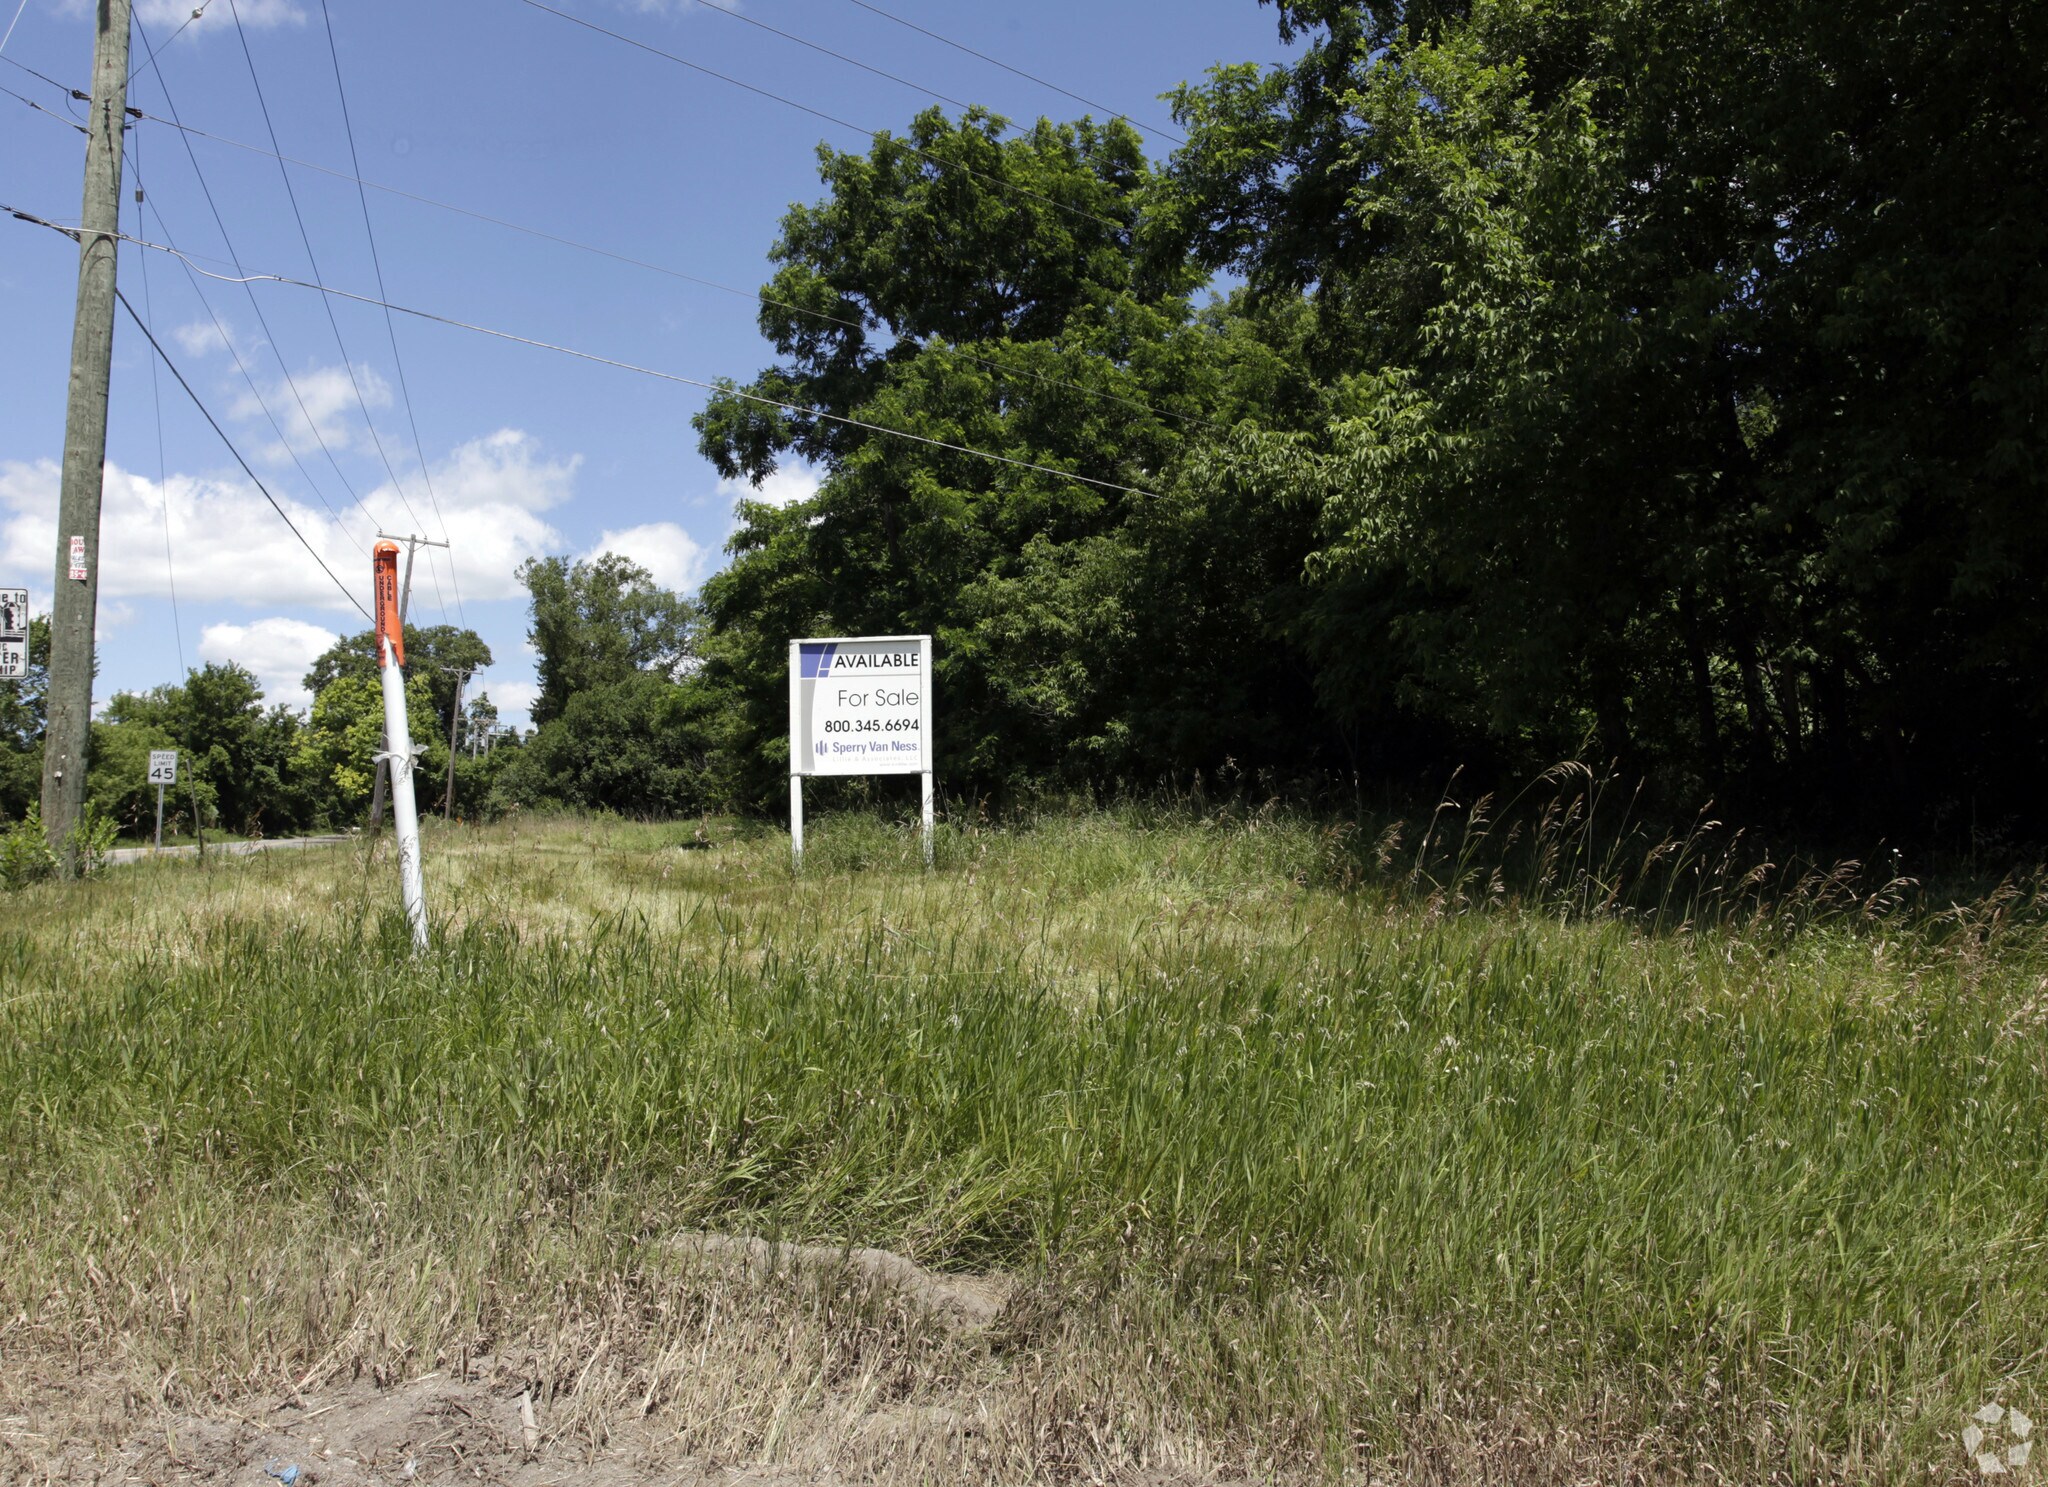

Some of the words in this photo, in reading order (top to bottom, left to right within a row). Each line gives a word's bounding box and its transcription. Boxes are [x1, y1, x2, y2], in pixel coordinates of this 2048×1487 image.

[15, 592, 26, 604] to
[834, 653, 919, 669] AVAILABLE
[838, 689, 869, 707] For
[875, 688, 919, 707] Sale
[824, 718, 920, 733] 800.345.6694
[832, 741, 867, 755] Sperry
[869, 741, 889, 752] Van
[891, 740, 918, 751] Ness
[905, 754, 919, 762] LLC
[151, 767, 174, 780] 45
